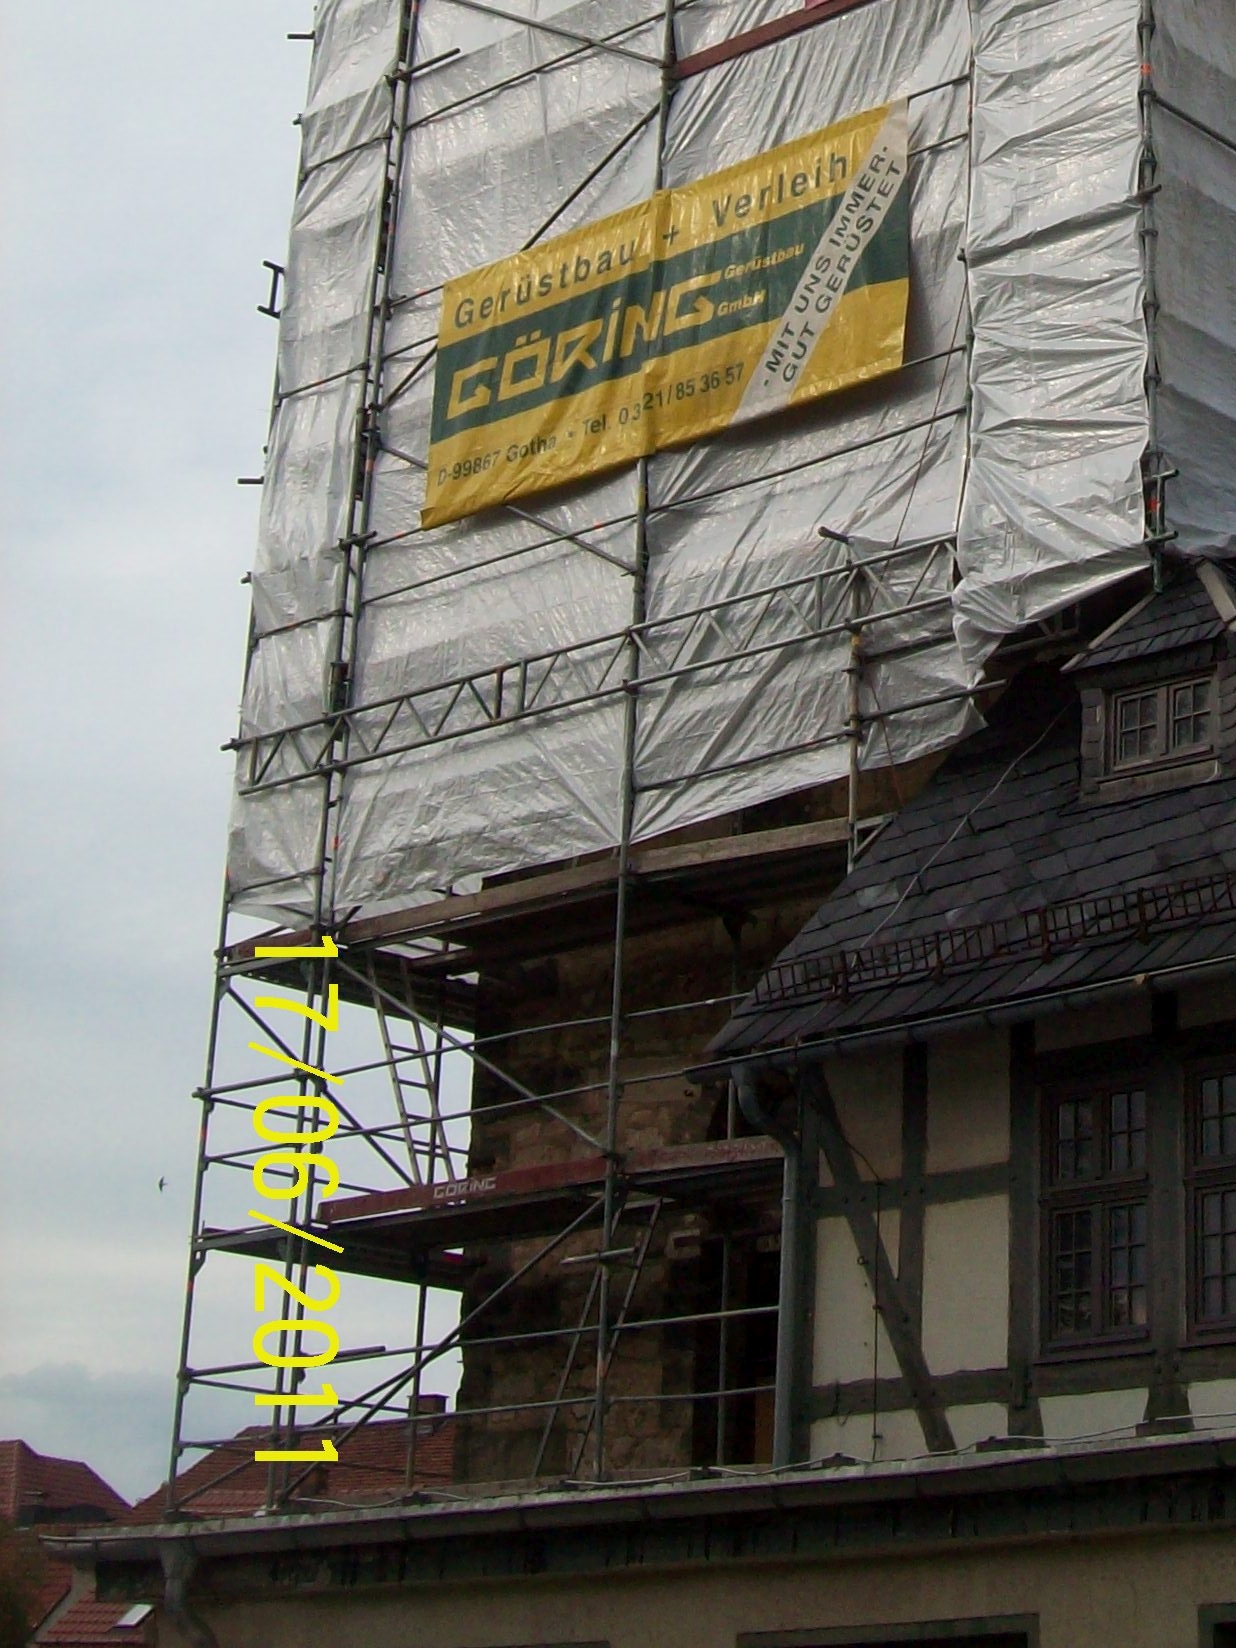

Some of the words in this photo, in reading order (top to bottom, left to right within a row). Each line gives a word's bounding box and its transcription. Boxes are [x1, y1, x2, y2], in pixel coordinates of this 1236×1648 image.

[454, 239, 637, 331] Gerüstbau
[711, 152, 848, 228] Verleih
[717, 288, 766, 319] GmbH
[721, 243, 805, 280] Gerüstbau
[782, 320, 816, 383] GUT
[815, 159, 901, 314] GERÜSTET
[794, 254, 831, 313] UNS
[447, 270, 721, 421] GÖRING
[437, 449, 499, 487] D-99867
[505, 434, 556, 463] Gotha
[582, 413, 612, 436] Tel.
[699, 369, 720, 394] 36
[724, 362, 745, 386] 57
